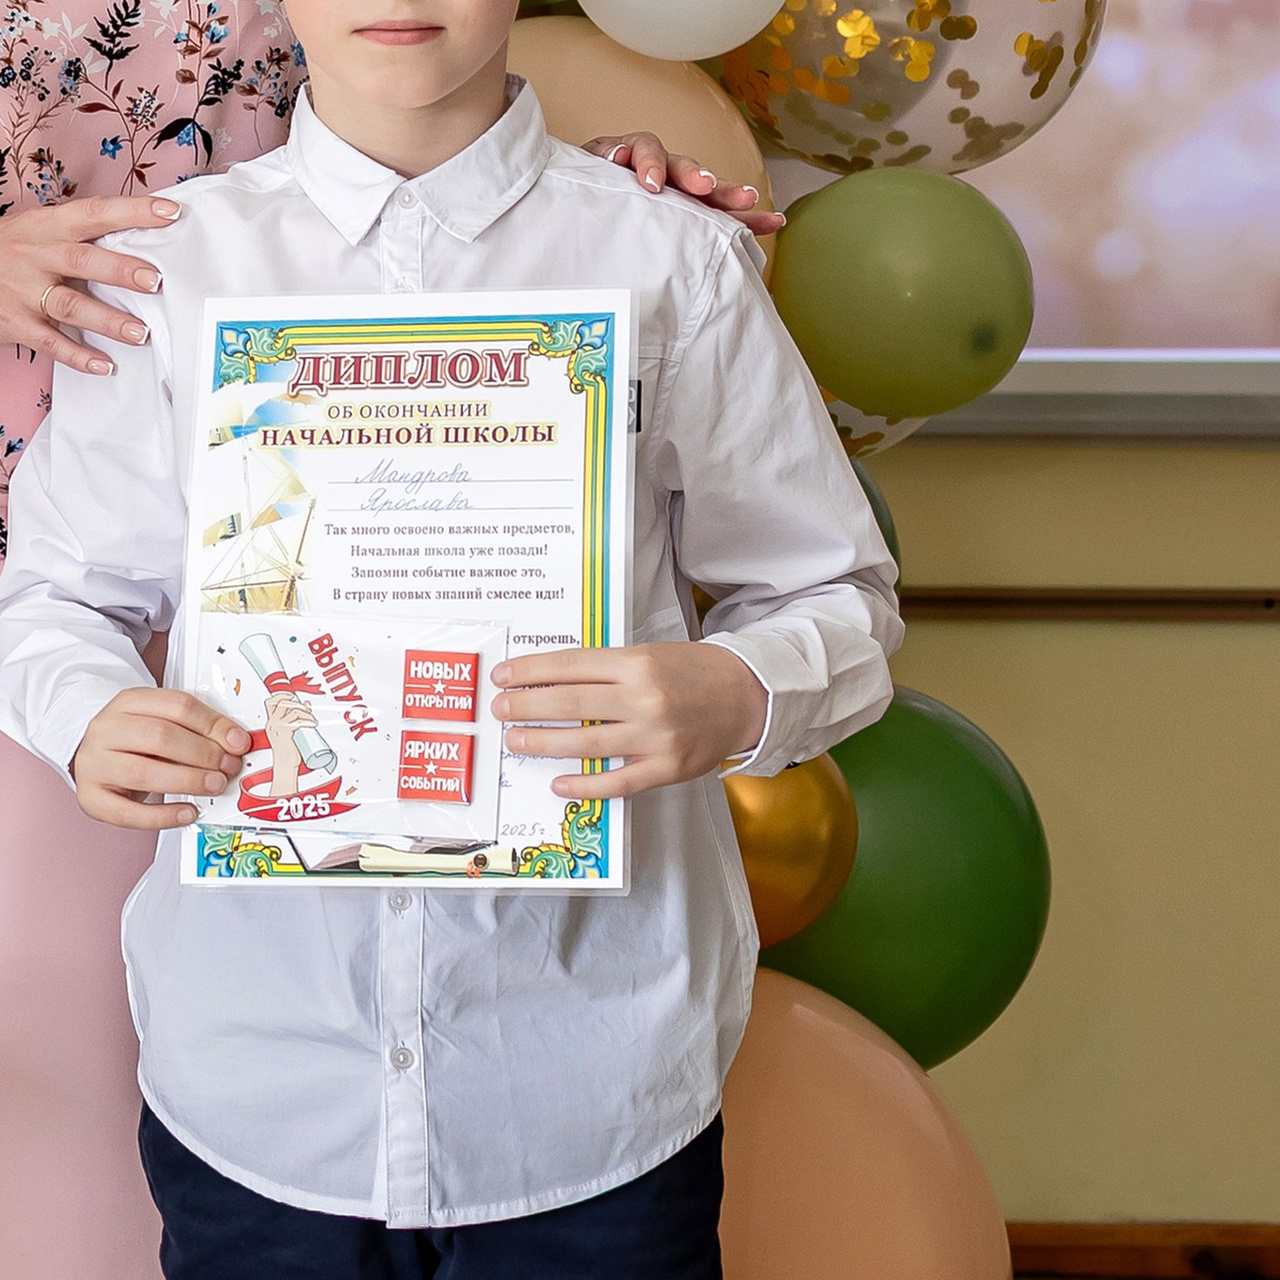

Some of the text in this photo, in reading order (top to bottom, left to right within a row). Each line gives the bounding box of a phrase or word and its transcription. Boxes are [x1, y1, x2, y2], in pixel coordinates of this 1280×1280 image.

[289, 350, 529, 396] ДИПЛОМ
[328, 403, 488, 419] ОБ ОКОНЧАНИИ
[261, 422, 555, 446] НАЧАЛЬНОЙ ШКОЛЫ
[324, 524, 575, 537] Так много освоено важных предметов,
[351, 544, 548, 559] Начальная школа уже позади!
[351, 566, 546, 579] Запомни событие важное это,
[333, 587, 564, 603] В страну новых знаний смелее иди!
[512, 634, 580, 647] откроешь,
[409, 660, 472, 681] НОВЫХ
[308, 633, 378, 742] ВЫПУСК
[405, 694, 473, 711] ОТКРЫТИЙ
[404, 740, 460, 761] ЯРКИХ
[400, 775, 460, 793] СОБЫТИЙ
[276, 792, 331, 821] 2025
